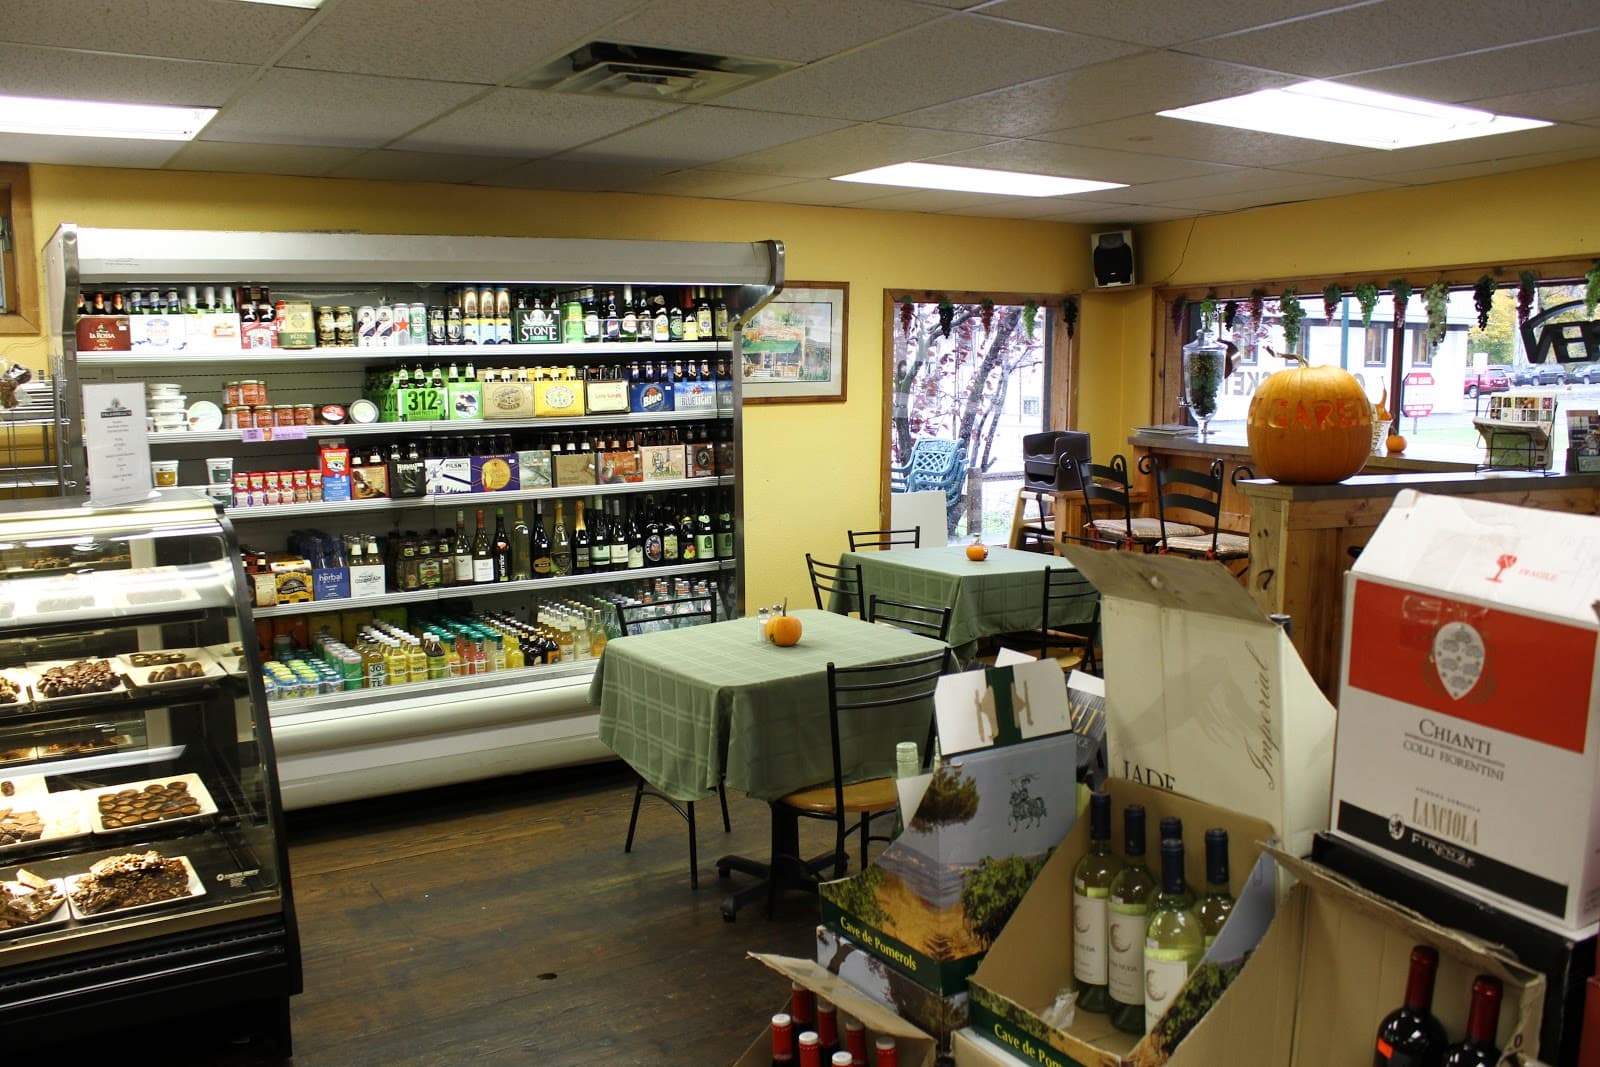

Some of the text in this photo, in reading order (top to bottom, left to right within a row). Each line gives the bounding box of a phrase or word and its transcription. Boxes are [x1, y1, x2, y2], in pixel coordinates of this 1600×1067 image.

[521, 326, 557, 341] STONE
[408, 390, 438, 411] 312
[1244, 640, 1280, 791] Imperial
[1419, 718, 1491, 756] CHIANTI
[1403, 740, 1505, 782] COLLI FIORENTINI
[1412, 797, 1479, 847] LANCIOLA
[1411, 832, 1476, 866] FIRENZE
[840, 916, 917, 971] Cave de Pomerols
[994, 1023, 1020, 1049] Cave
[1022, 1039, 1036, 1058] de
